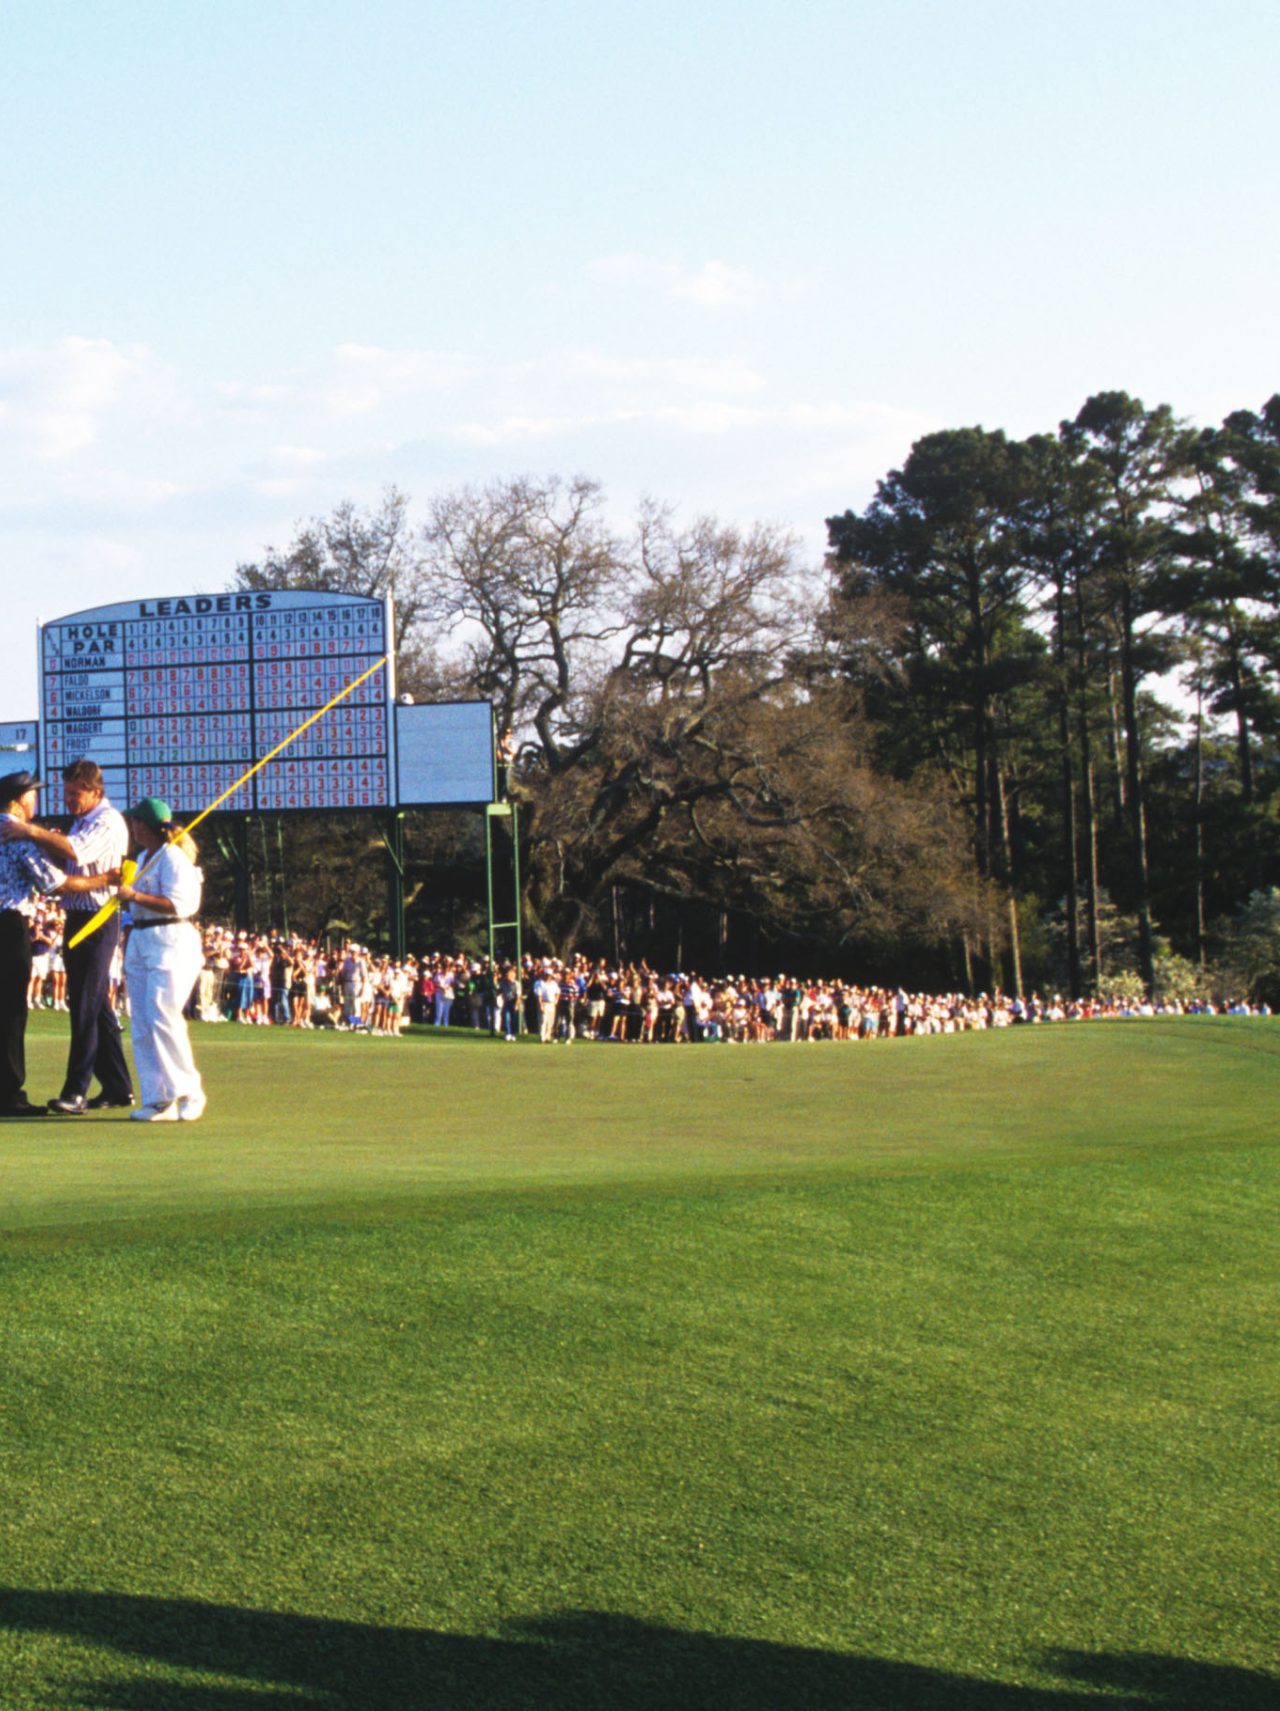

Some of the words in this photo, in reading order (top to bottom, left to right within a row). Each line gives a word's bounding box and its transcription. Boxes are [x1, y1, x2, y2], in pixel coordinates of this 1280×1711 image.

[140, 594, 271, 617] LEADERS
[68, 624, 117, 639] HOLE
[142, 623, 148, 634] 2
[155, 623, 162, 634] 3
[168, 621, 175, 631] 4
[183, 620, 189, 631] 5
[196, 619, 202, 630] 6
[211, 617, 217, 628] 7
[224, 617, 230, 629] 8
[238, 616, 244, 628] 9
[255, 615, 264, 626] 10
[271, 614, 277, 625] 11
[284, 613, 293, 624] 12
[299, 612, 307, 623] 13
[313, 611, 321, 622] 14
[328, 610, 336, 621] 15
[342, 609, 350, 620] 16
[356, 608, 365, 619] 17
[371, 607, 379, 618] 18
[74, 640, 114, 654] PAR
[128, 639, 135, 650] 4
[142, 638, 148, 649] 5
[155, 637, 162, 648] 4
[170, 636, 176, 647] 3
[182, 636, 189, 646] 4
[197, 634, 203, 646] 3
[210, 634, 217, 644] 4
[224, 633, 230, 644] 5
[238, 632, 245, 642] 4
[256, 630, 263, 641] 4
[270, 630, 276, 640] 4
[285, 629, 291, 640] 3
[299, 627, 306, 638] 5
[313, 627, 320, 637] 4
[328, 626, 335, 637] 5
[343, 625, 350, 637] 3
[358, 624, 364, 634] 4
[372, 623, 378, 633] 4
[64, 656, 106, 668] NORMAN
[64, 675, 88, 686] FALDO
[65, 690, 110, 700] MICKELSON
[16, 728, 26, 740] 17
[66, 738, 91, 749] FROST
